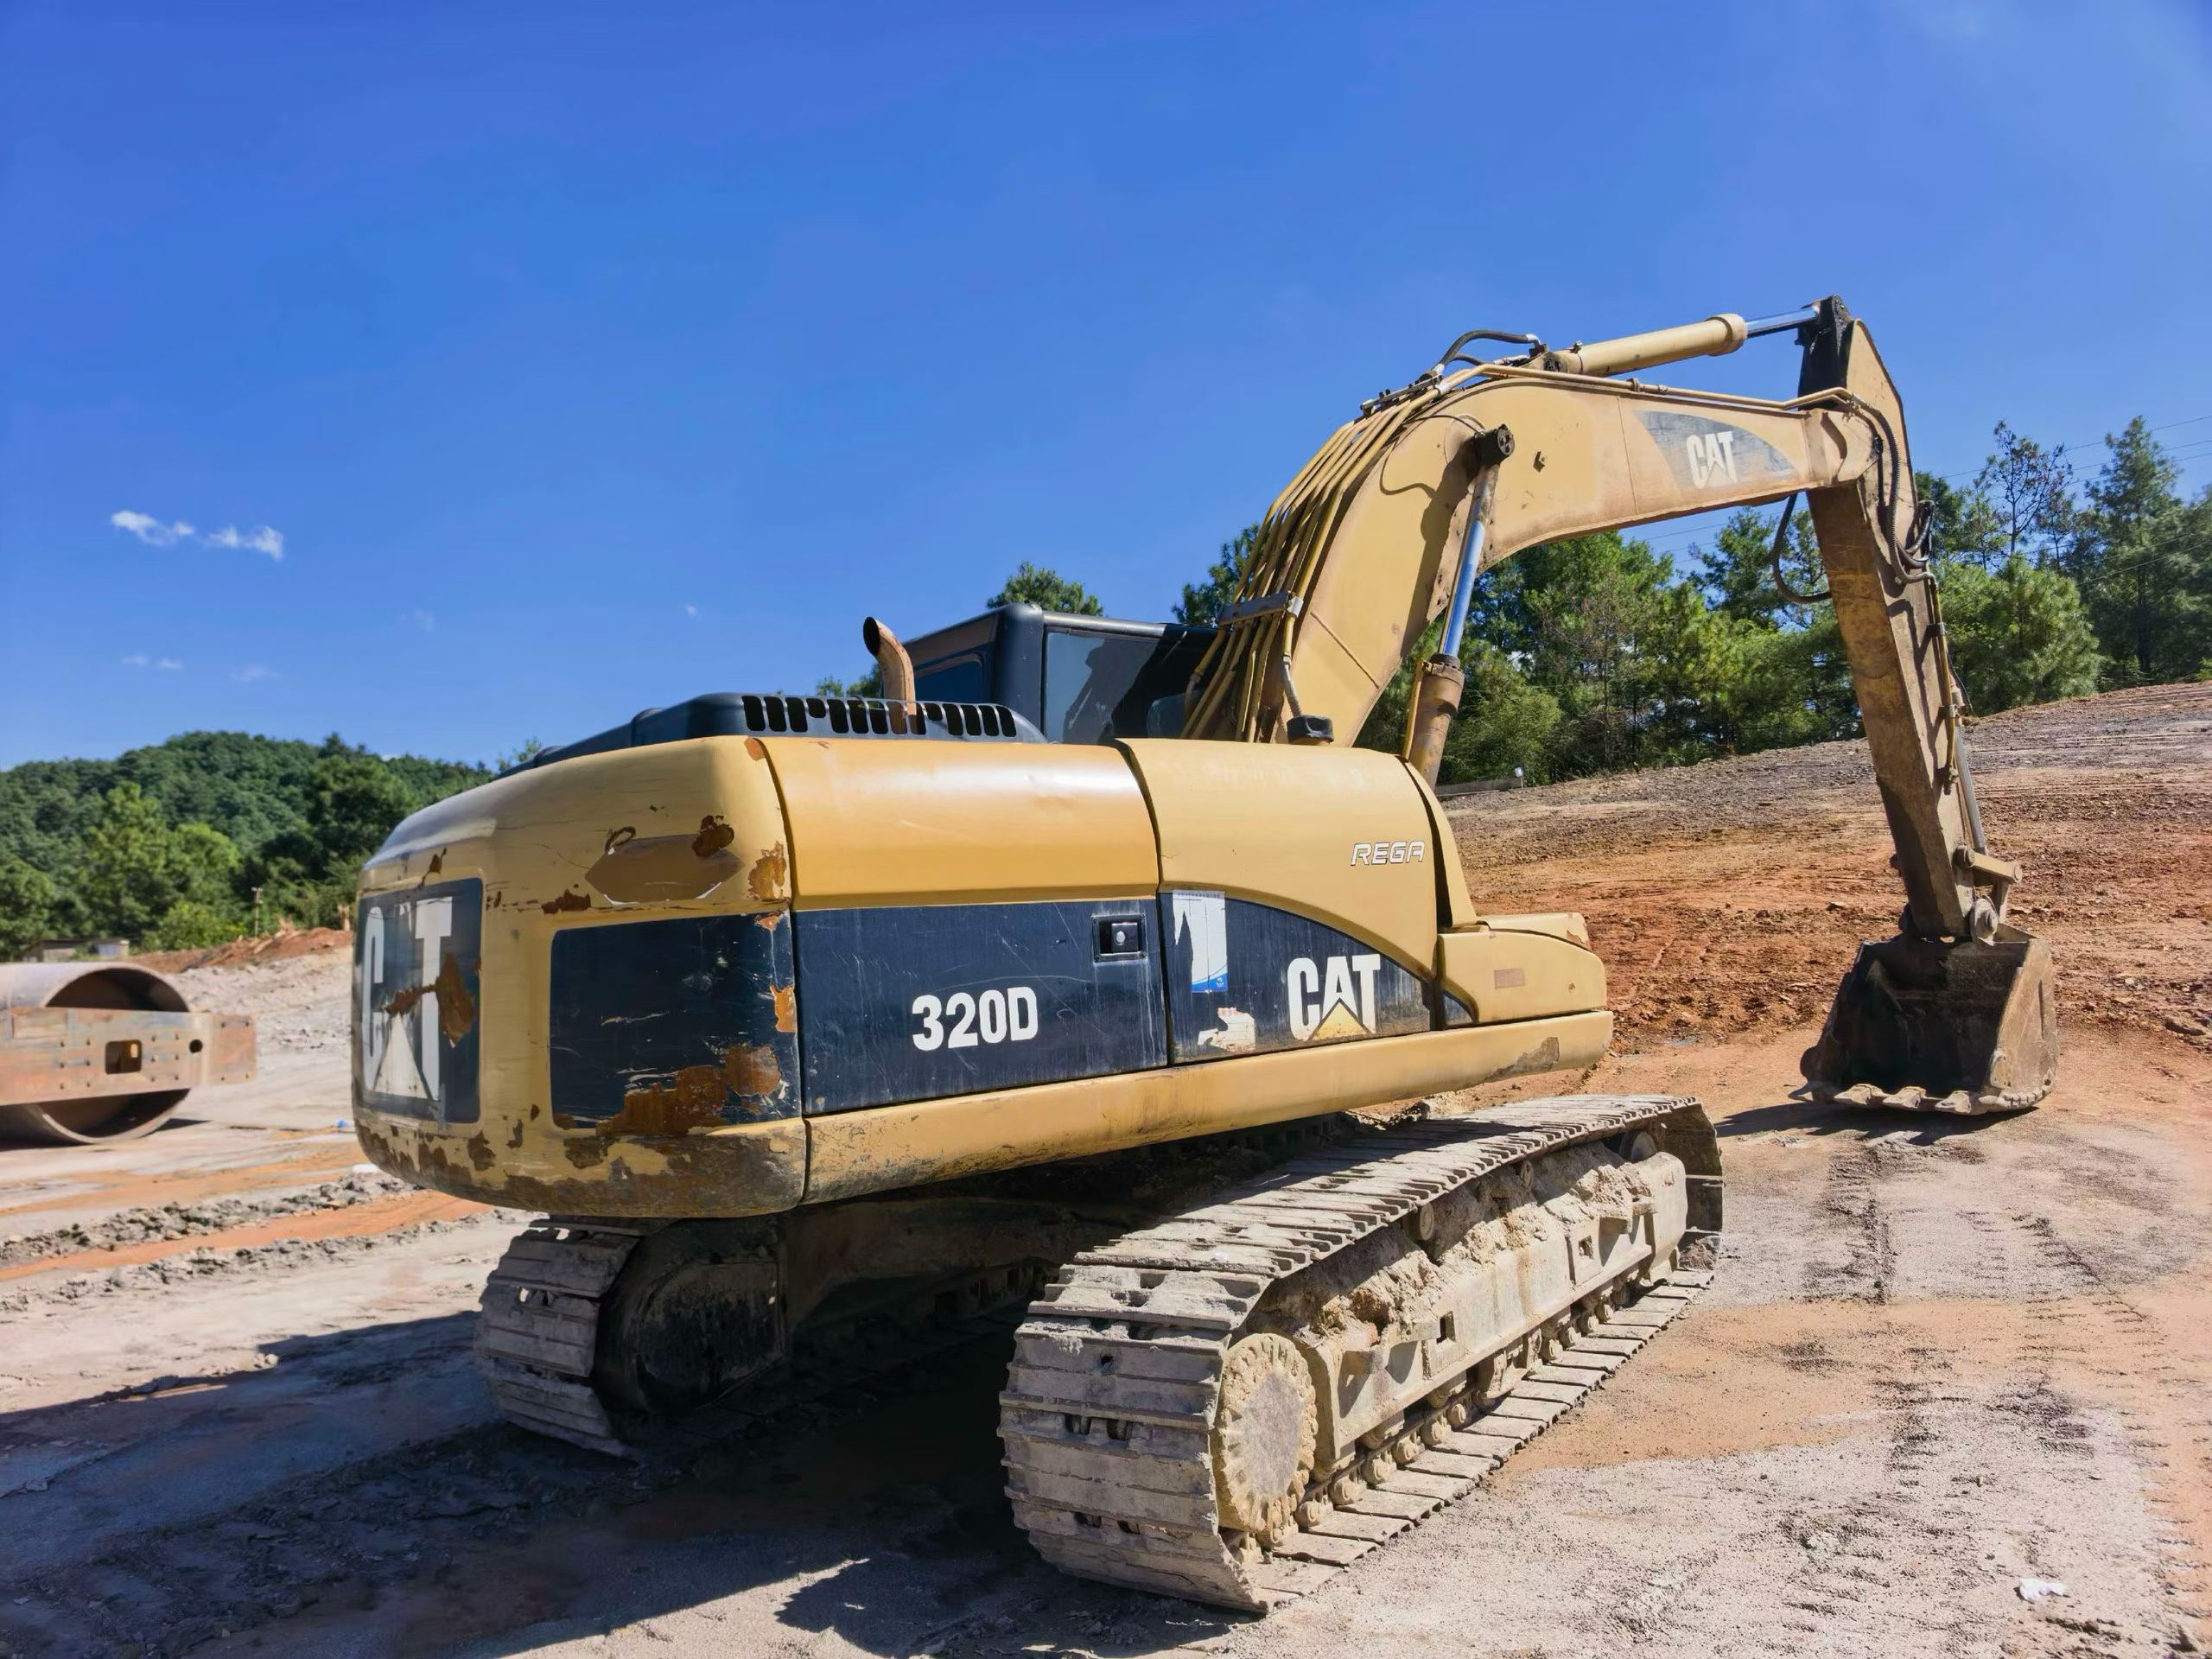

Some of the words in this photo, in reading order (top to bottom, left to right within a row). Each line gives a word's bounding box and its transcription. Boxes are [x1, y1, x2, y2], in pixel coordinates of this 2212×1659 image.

[1686, 430, 1738, 489] CAT
[1350, 840, 1425, 866] REGA
[362, 896, 453, 1102] CT
[912, 986, 1038, 1052] 320D
[1287, 953, 1381, 1041] CAT
